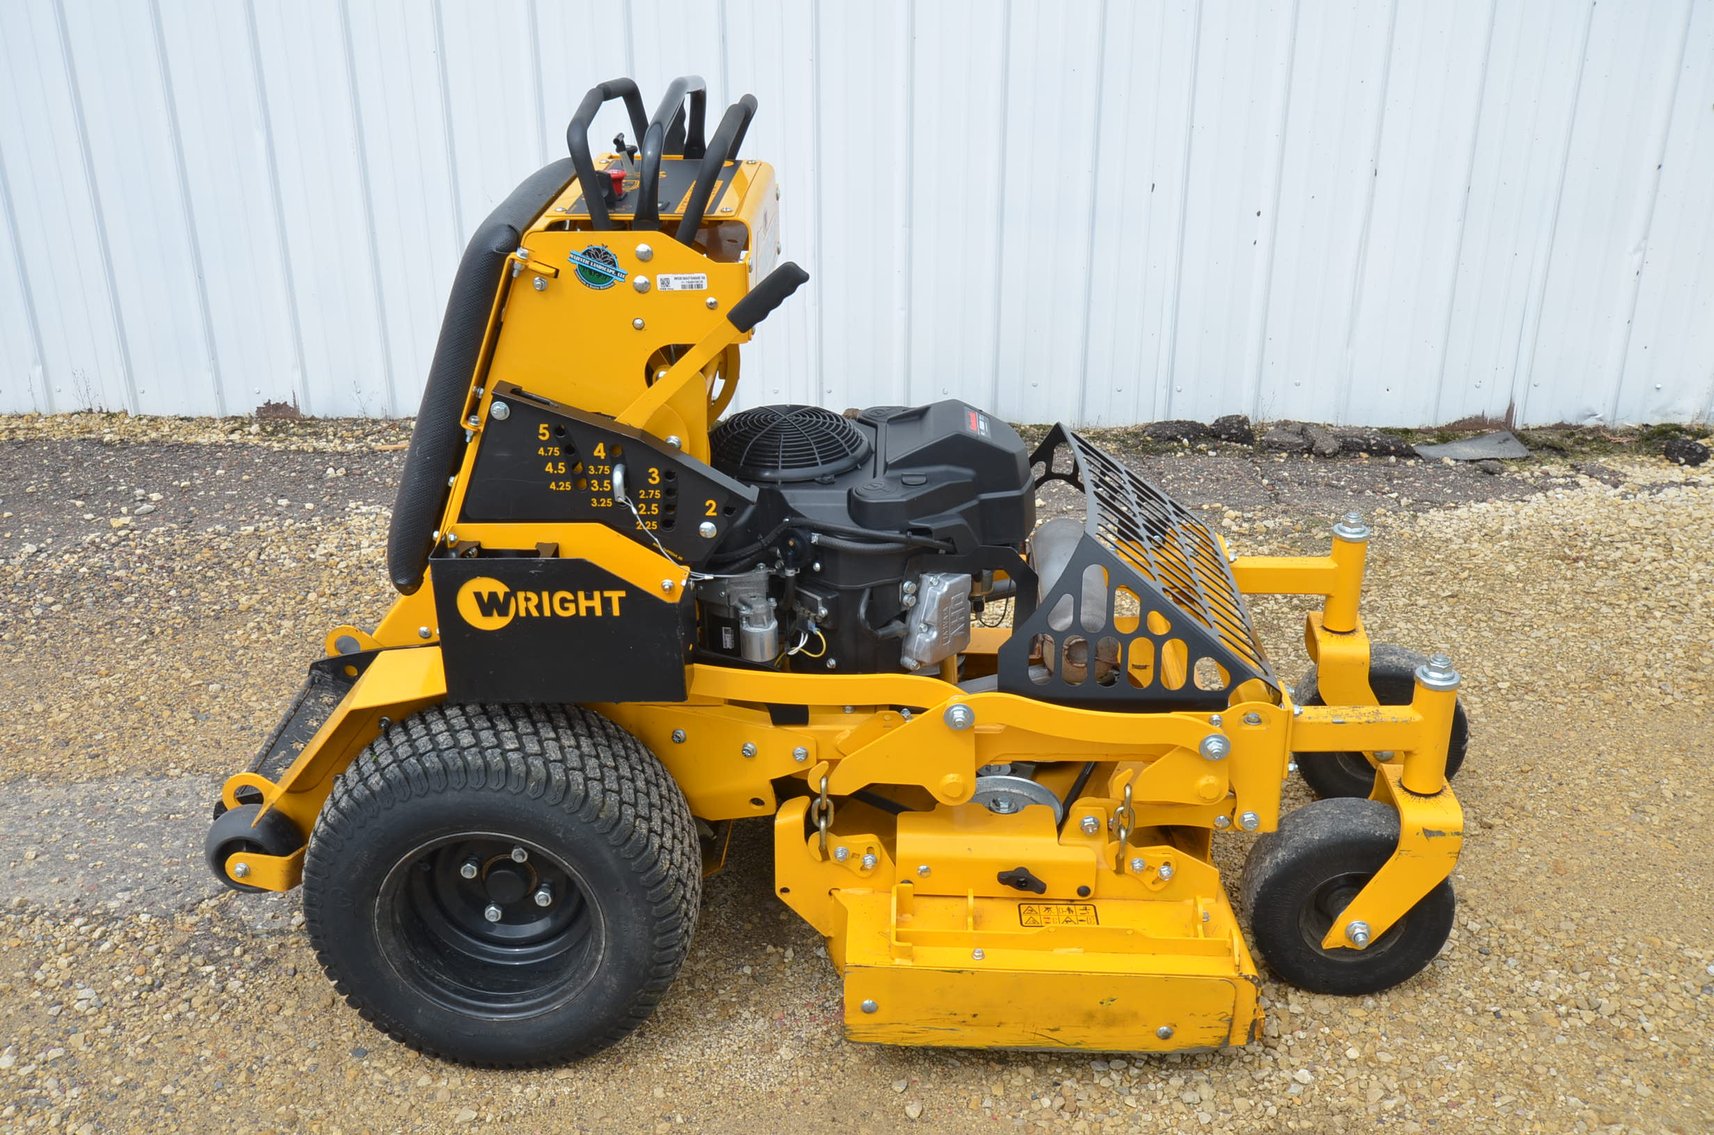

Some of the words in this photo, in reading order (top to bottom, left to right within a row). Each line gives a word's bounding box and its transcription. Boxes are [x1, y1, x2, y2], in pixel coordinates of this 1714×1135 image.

[537, 423, 550, 441] 5
[537, 446, 560, 457] 4.75
[593, 442, 607, 460] 4
[544, 461, 566, 474] 4.5
[588, 464, 611, 475] 3.75
[648, 467, 661, 485] 3
[549, 481, 572, 492] 4.25
[590, 479, 612, 492] 3.5
[639, 489, 661, 499] 2.75
[591, 497, 613, 508] 3.25
[704, 499, 718, 517] 2
[638, 503, 659, 515] 2.5
[636, 520, 658, 530] 225
[473, 590, 627, 618] WRIGHT
